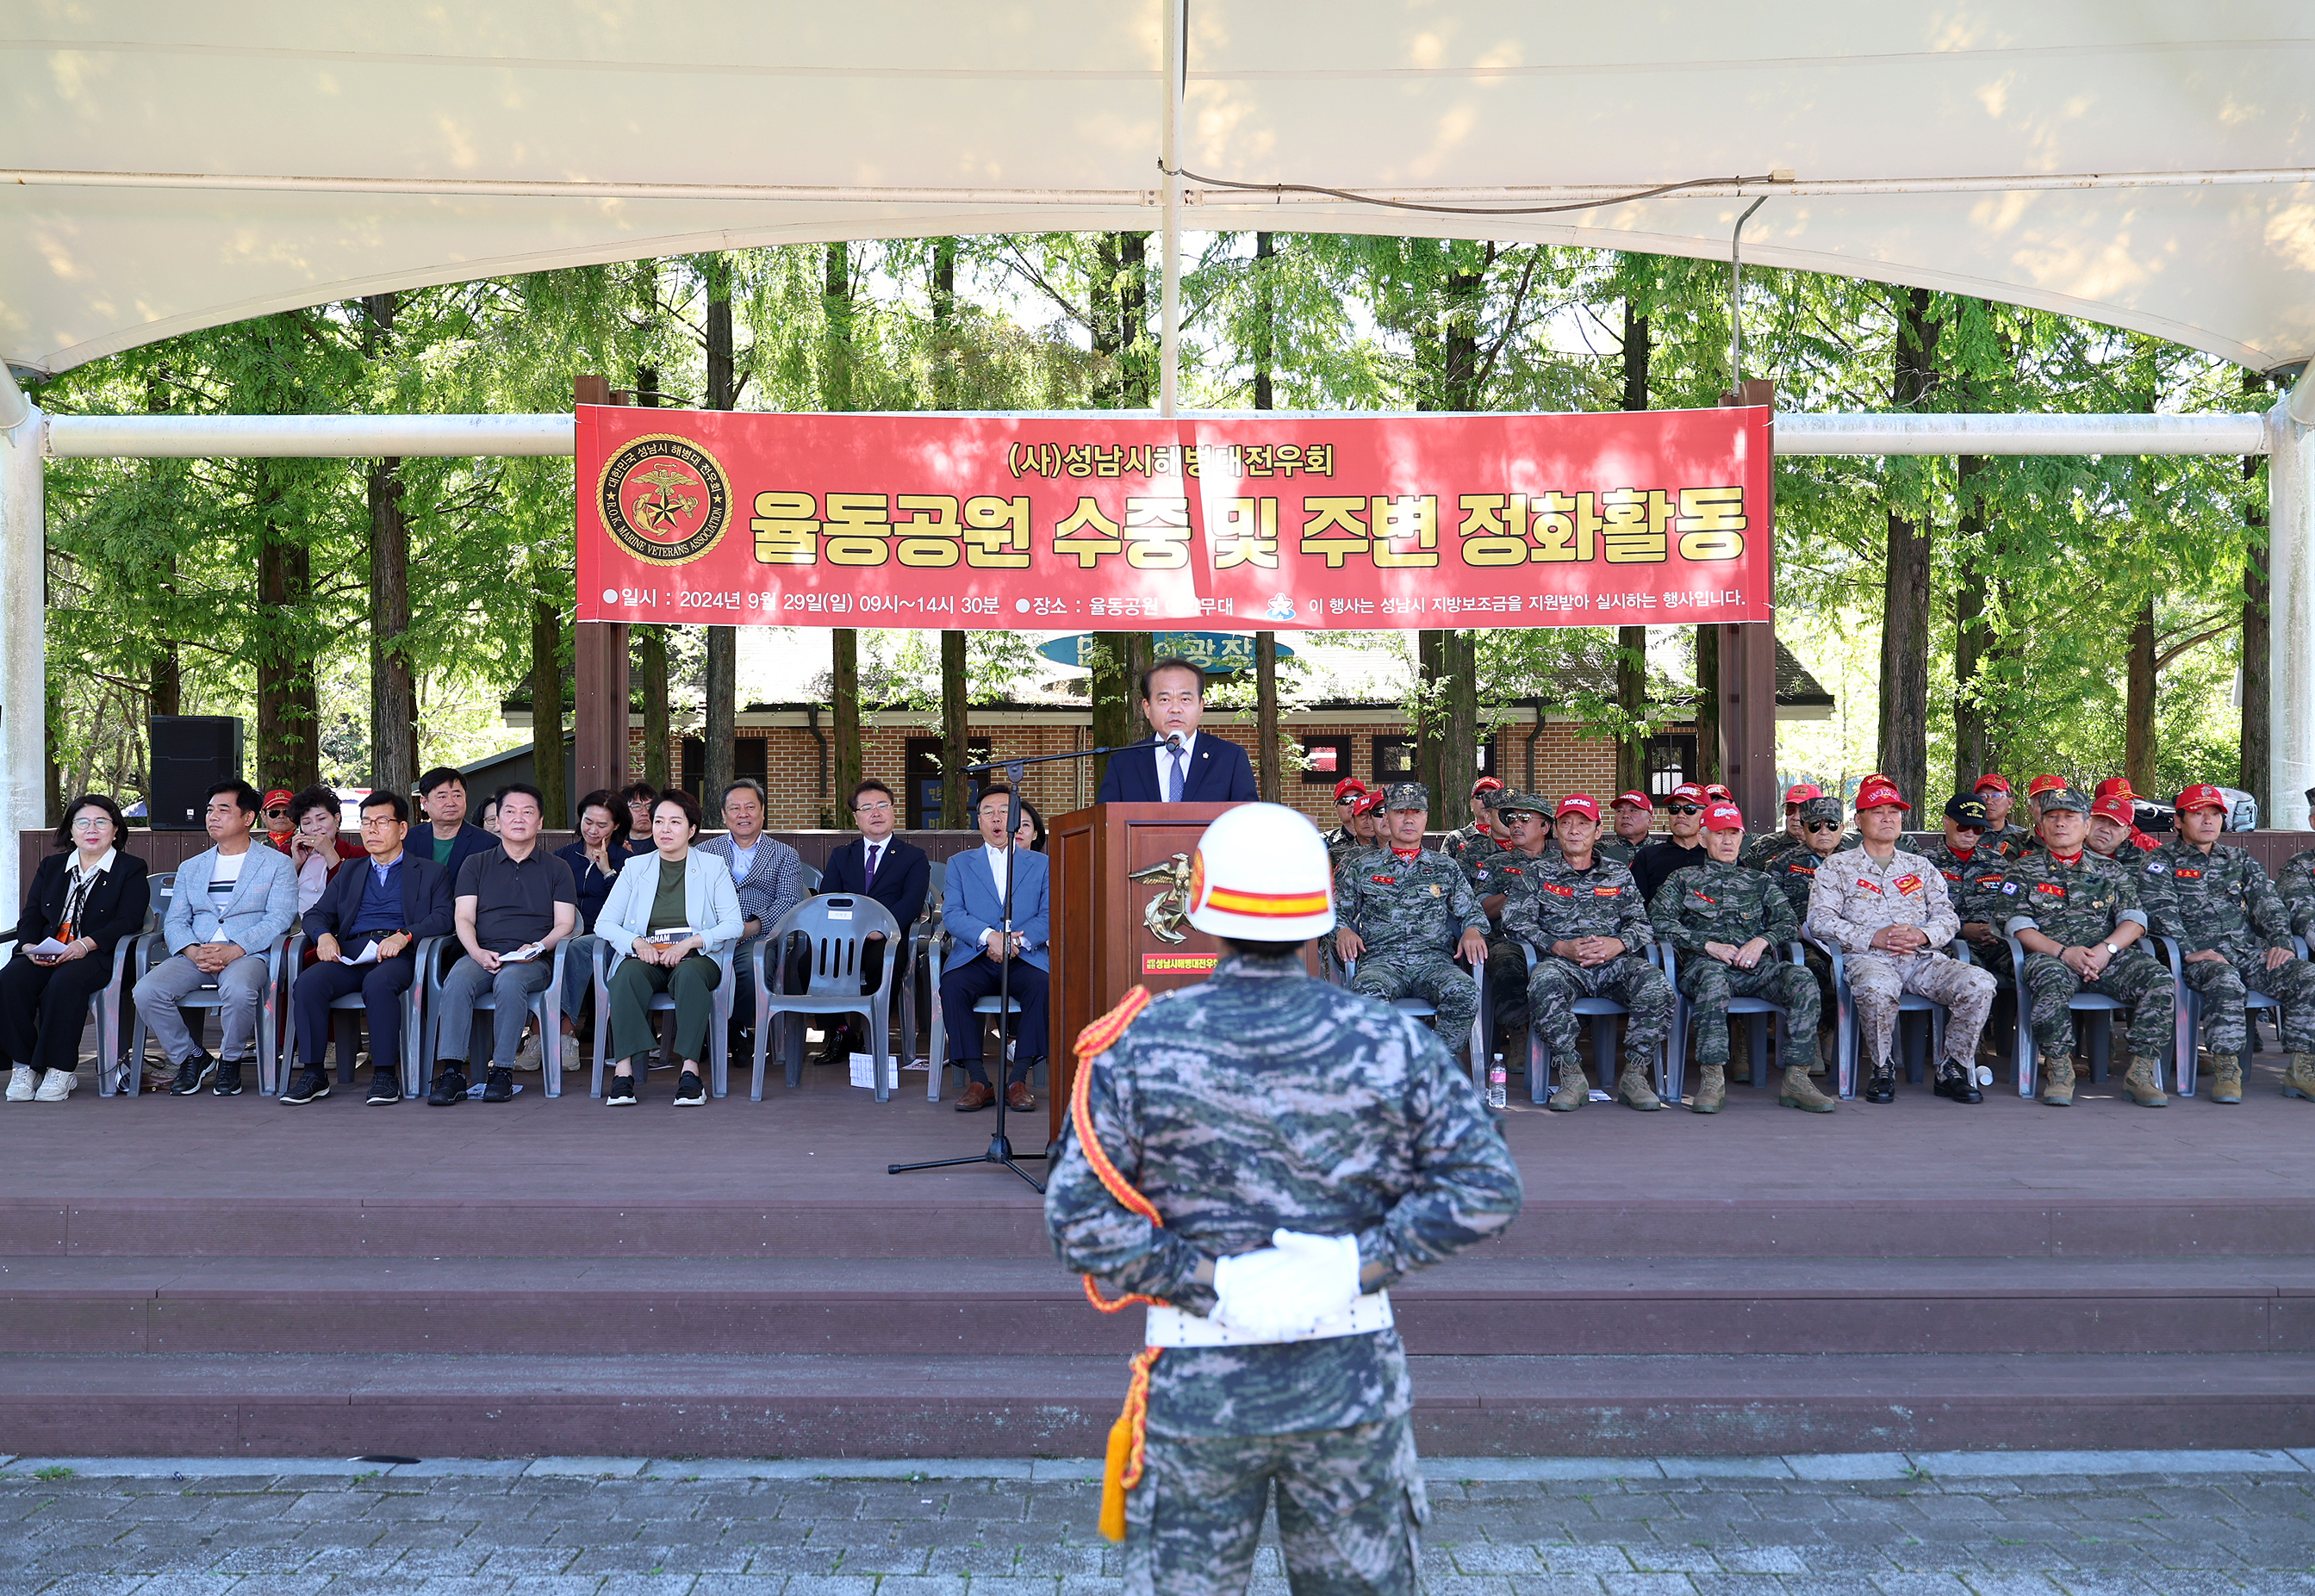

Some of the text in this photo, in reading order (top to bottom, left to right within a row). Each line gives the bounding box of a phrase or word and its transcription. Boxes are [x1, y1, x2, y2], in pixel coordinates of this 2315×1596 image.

[608, 443, 722, 493] 대한민국 성남시 해병대 전우회
[606, 501, 724, 557] R.O.K. MARINE VETERANS ASSOCIATION
[750, 486, 1748, 570] 율동공원 수중 및 주변 정화활동
[621, 587, 657, 607] 일시
[680, 591, 741, 610] 2024년
[748, 592, 777, 612] 9월
[783, 593, 854, 613] 29일(일)
[961, 595, 1000, 614] 30분
[1033, 597, 1068, 616] 장소
[1089, 597, 1159, 616] 율동공원
[1309, 589, 1746, 614] 이 행사는 성남시 지방보조금을 지원받아 실시하는 행사입니다.
